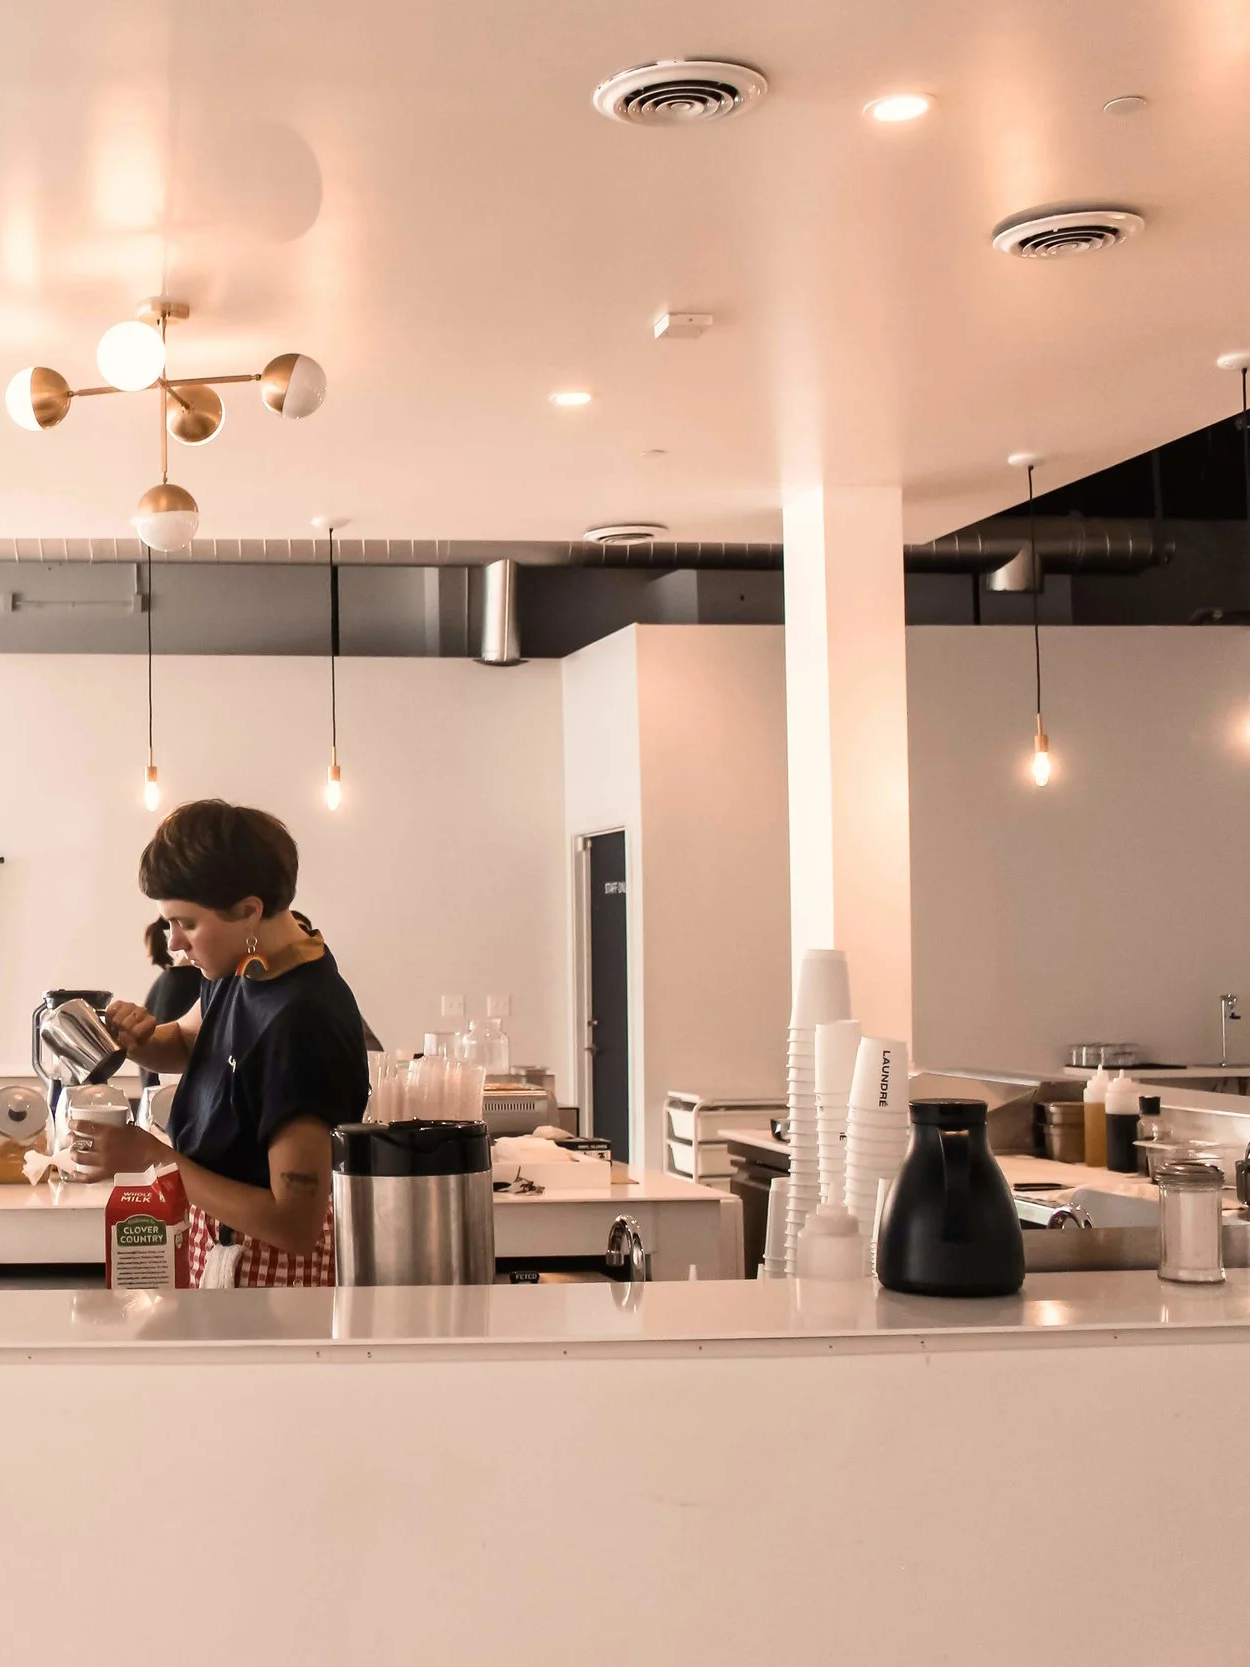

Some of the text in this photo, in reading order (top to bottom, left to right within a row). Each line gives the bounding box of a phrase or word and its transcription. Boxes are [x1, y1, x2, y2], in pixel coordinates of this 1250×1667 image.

[878, 1050, 891, 1107] LAUNDRÉ
[123, 1226, 159, 1235] CLOVER
[120, 1235, 164, 1244] COUNTRY
